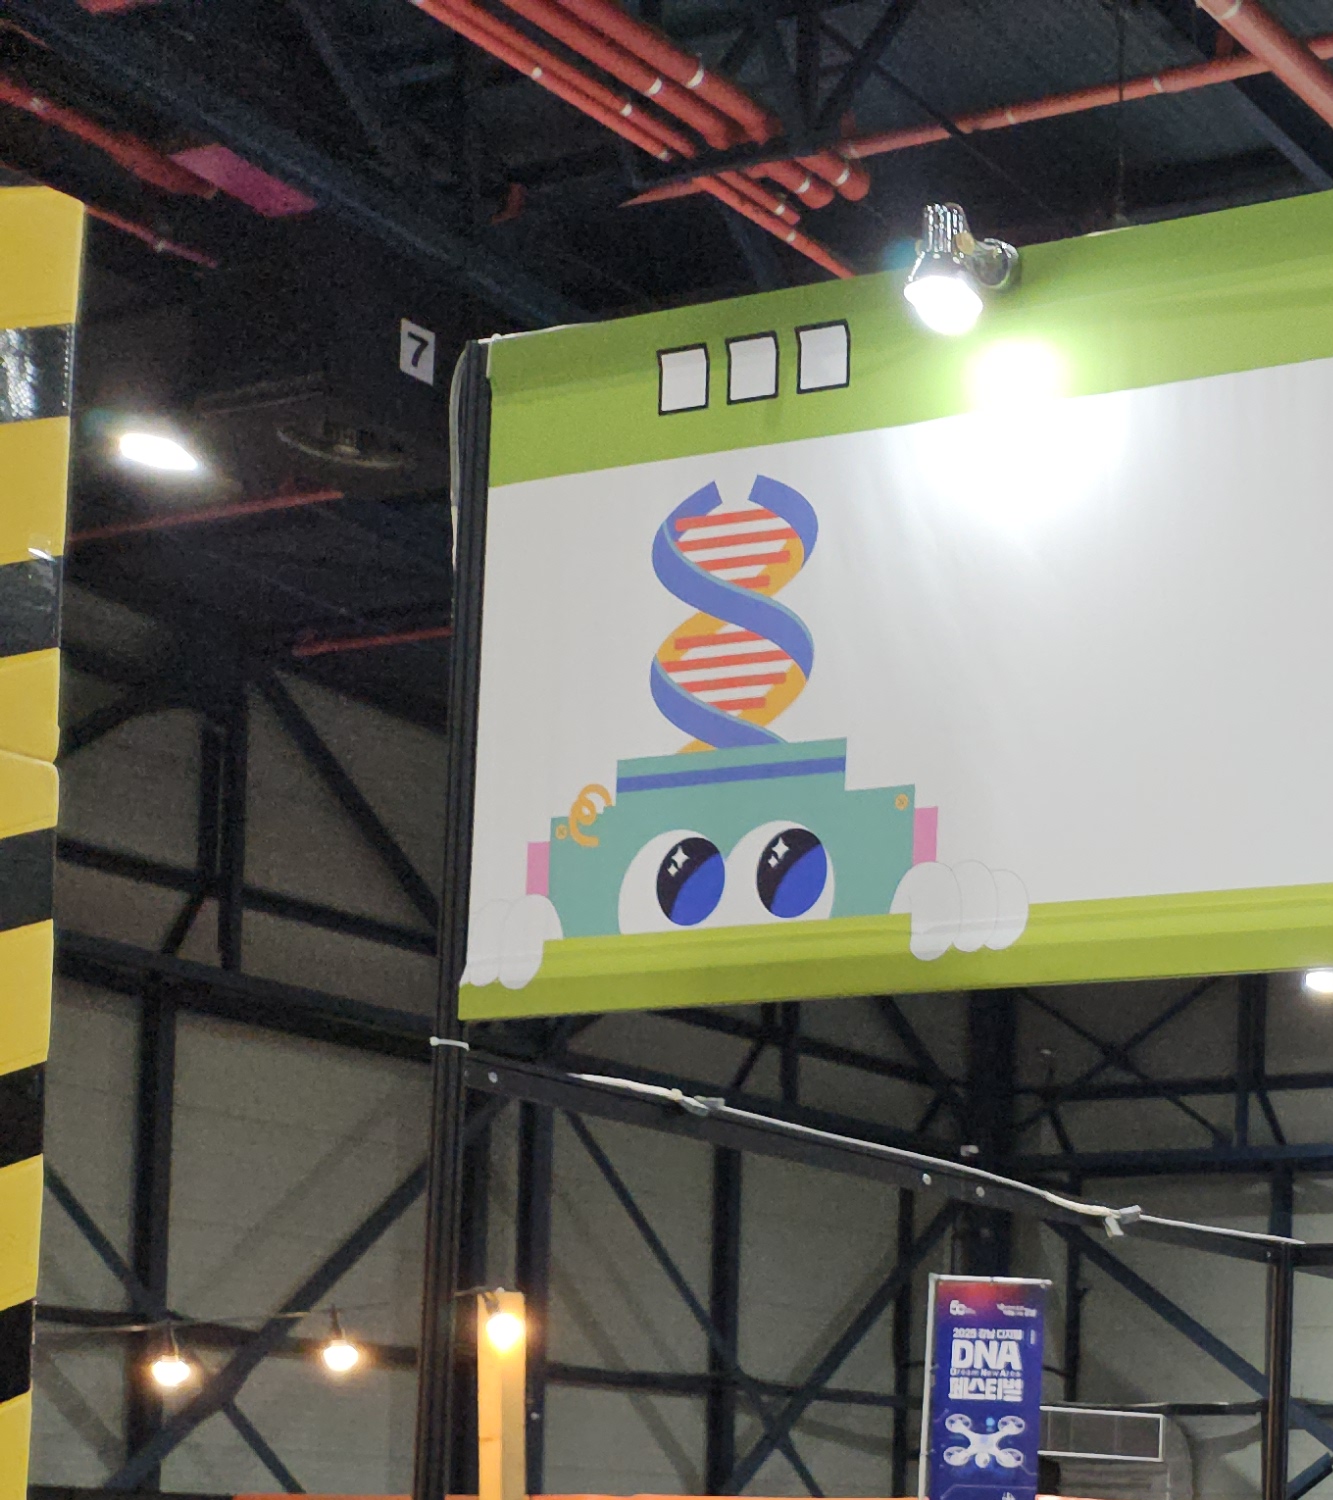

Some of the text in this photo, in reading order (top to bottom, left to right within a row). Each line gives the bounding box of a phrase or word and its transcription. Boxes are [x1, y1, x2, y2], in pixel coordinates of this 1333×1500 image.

[408, 331, 429, 368] 7
[951, 1339, 1022, 1370] DNA
[948, 1377, 1023, 1402] 페스티벌
